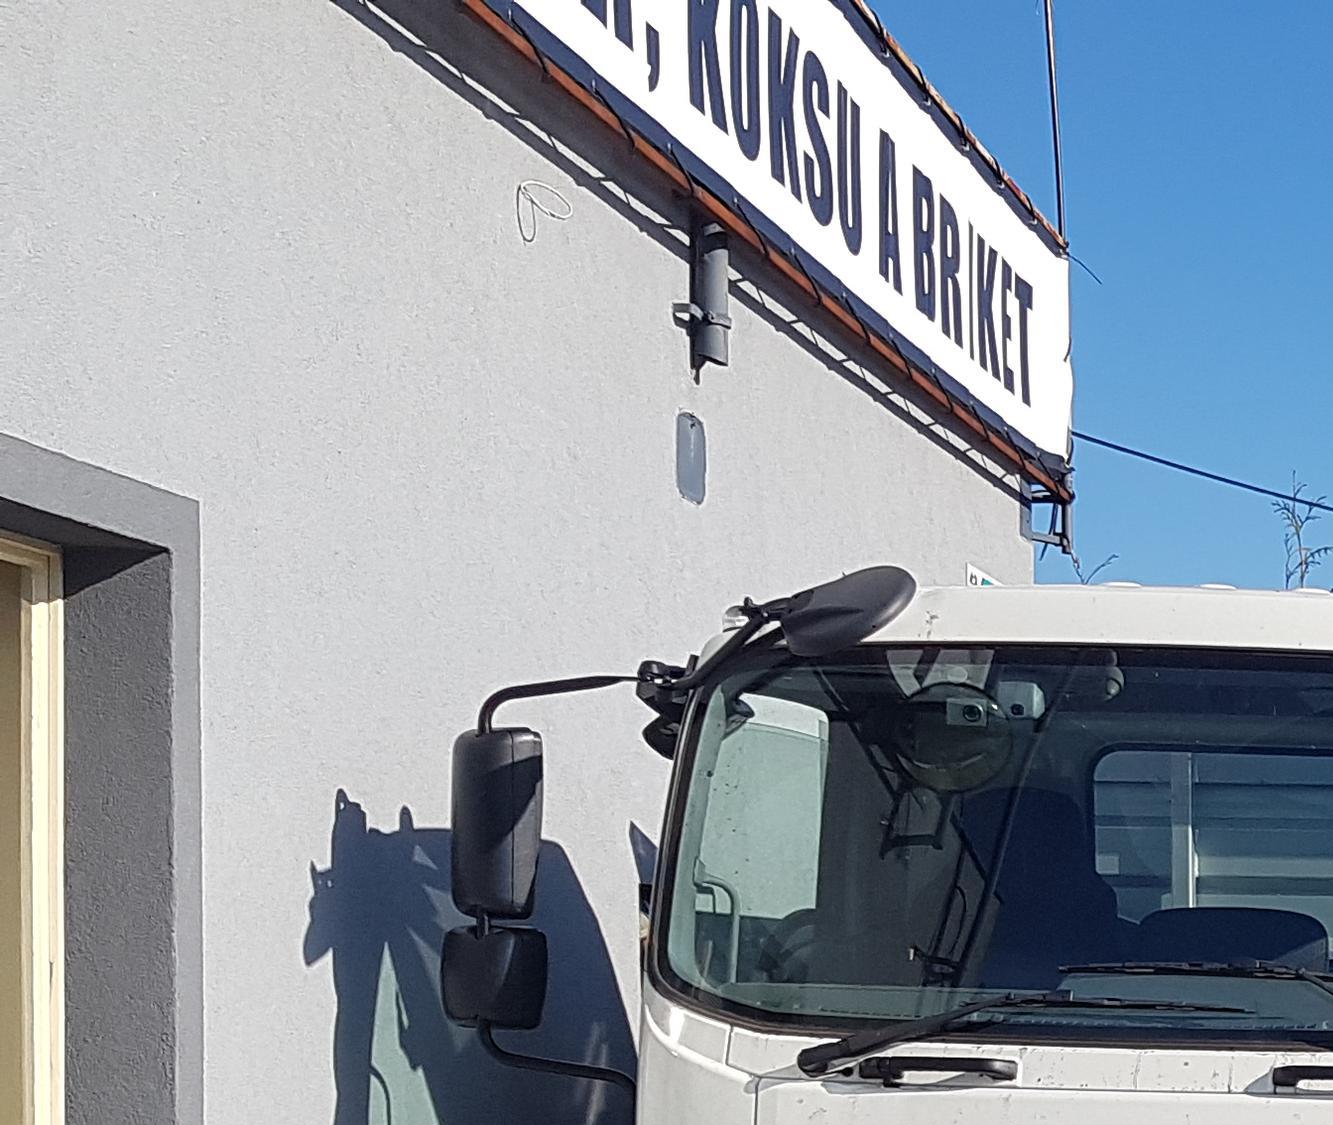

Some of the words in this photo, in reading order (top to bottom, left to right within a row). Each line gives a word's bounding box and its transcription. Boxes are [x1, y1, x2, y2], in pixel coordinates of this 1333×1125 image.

[687, 0, 863, 256] KOKSU
[878, 128, 903, 296] A
[912, 164, 1033, 408] BRIKET
